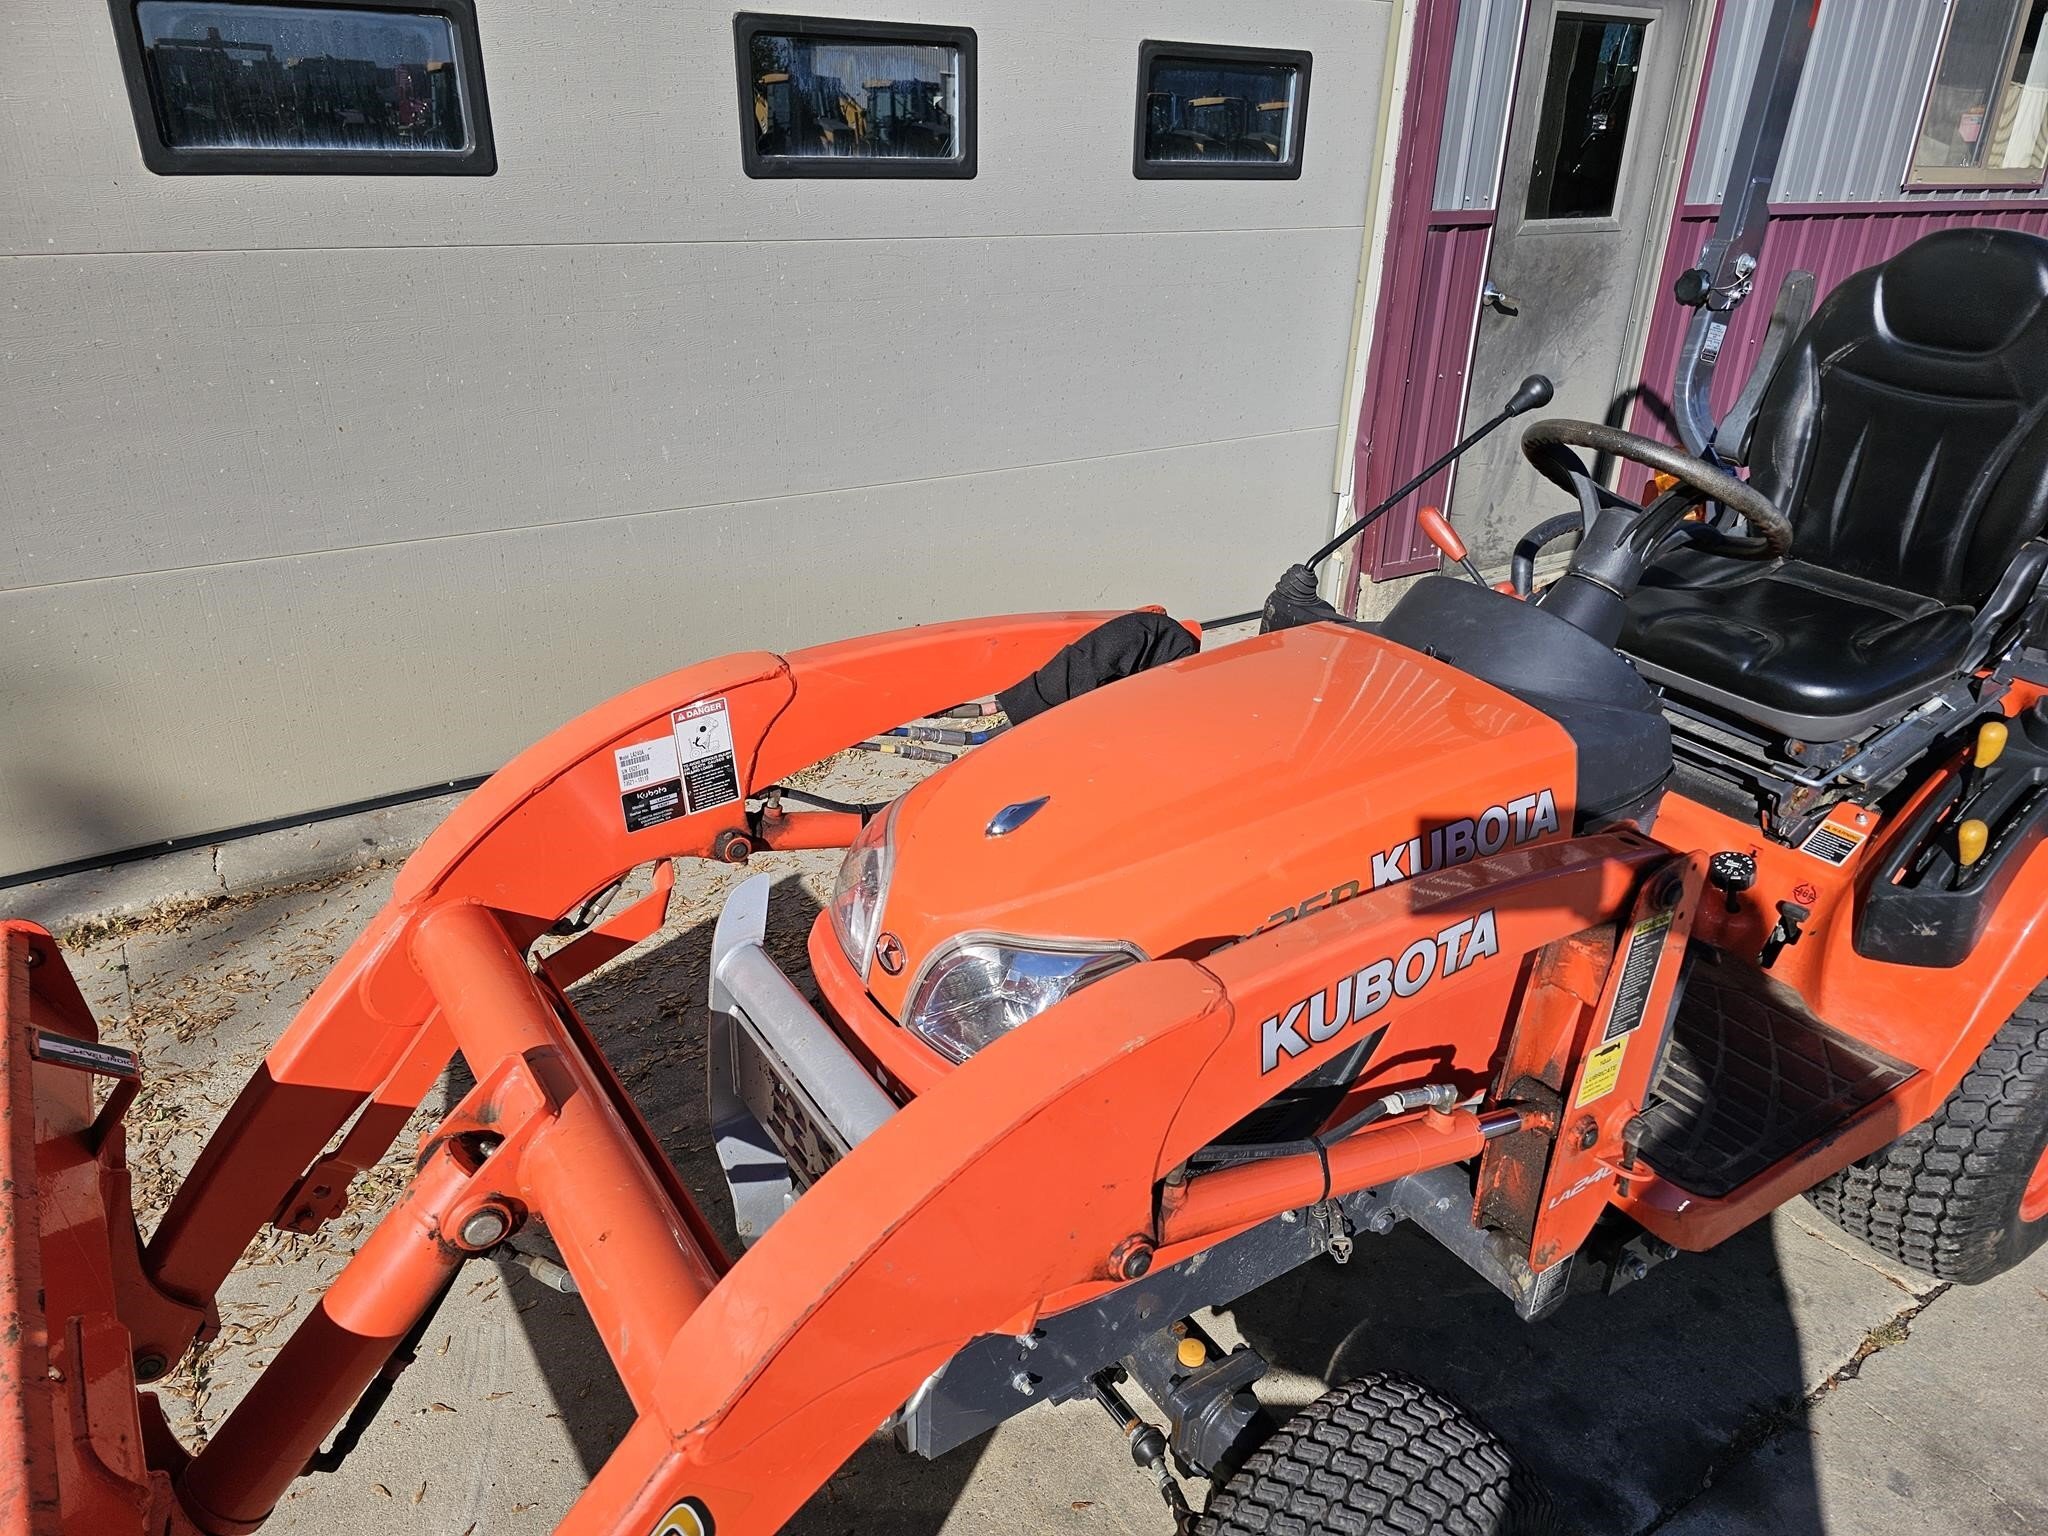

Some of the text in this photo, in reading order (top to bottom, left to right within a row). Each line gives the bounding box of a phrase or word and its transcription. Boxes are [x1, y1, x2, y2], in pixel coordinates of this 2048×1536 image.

[686, 703, 722, 719] DANGER
[1371, 789, 1558, 891] KUBOTA
[1260, 908, 1499, 1076] KUBOTA
